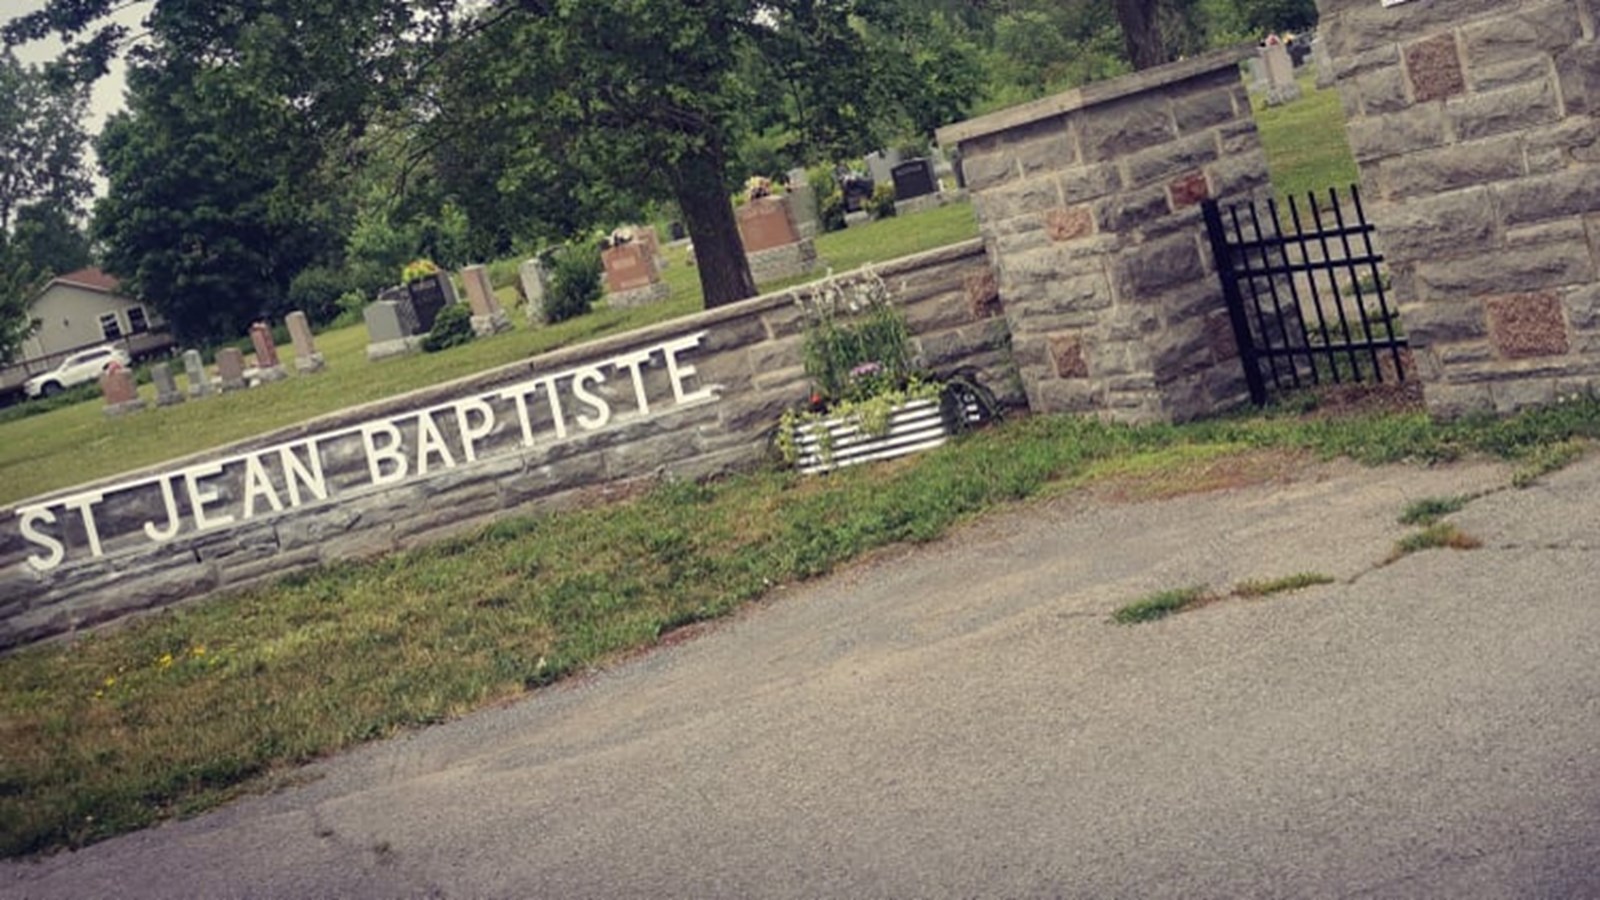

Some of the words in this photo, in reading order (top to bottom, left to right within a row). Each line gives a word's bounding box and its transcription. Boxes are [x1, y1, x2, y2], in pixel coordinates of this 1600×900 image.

[17, 496, 105, 572] ST
[144, 440, 329, 542] JEAN
[363, 333, 717, 485] BAPTISTE
